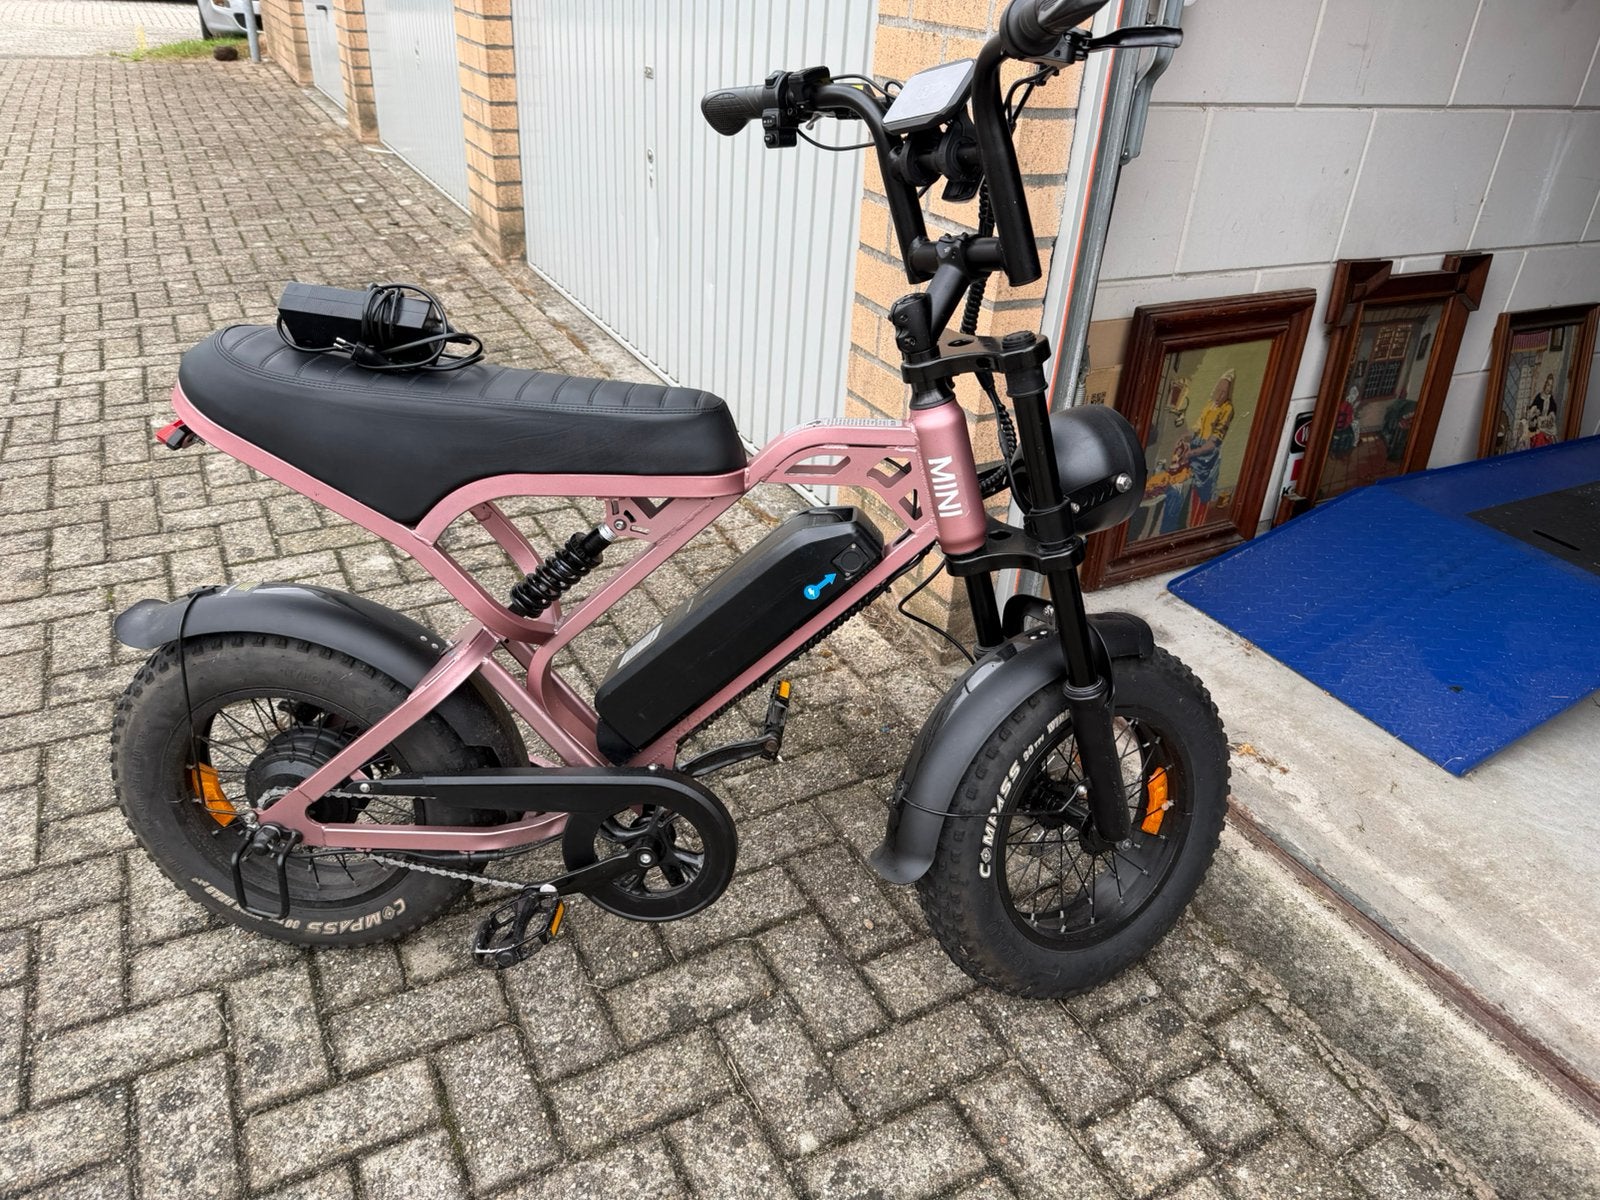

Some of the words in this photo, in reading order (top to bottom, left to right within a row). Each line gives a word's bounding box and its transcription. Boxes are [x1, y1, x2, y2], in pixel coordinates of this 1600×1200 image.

[927, 455, 963, 518] MINI
[978, 760, 1021, 879] COMPASS
[304, 898, 406, 935] COMPASS
